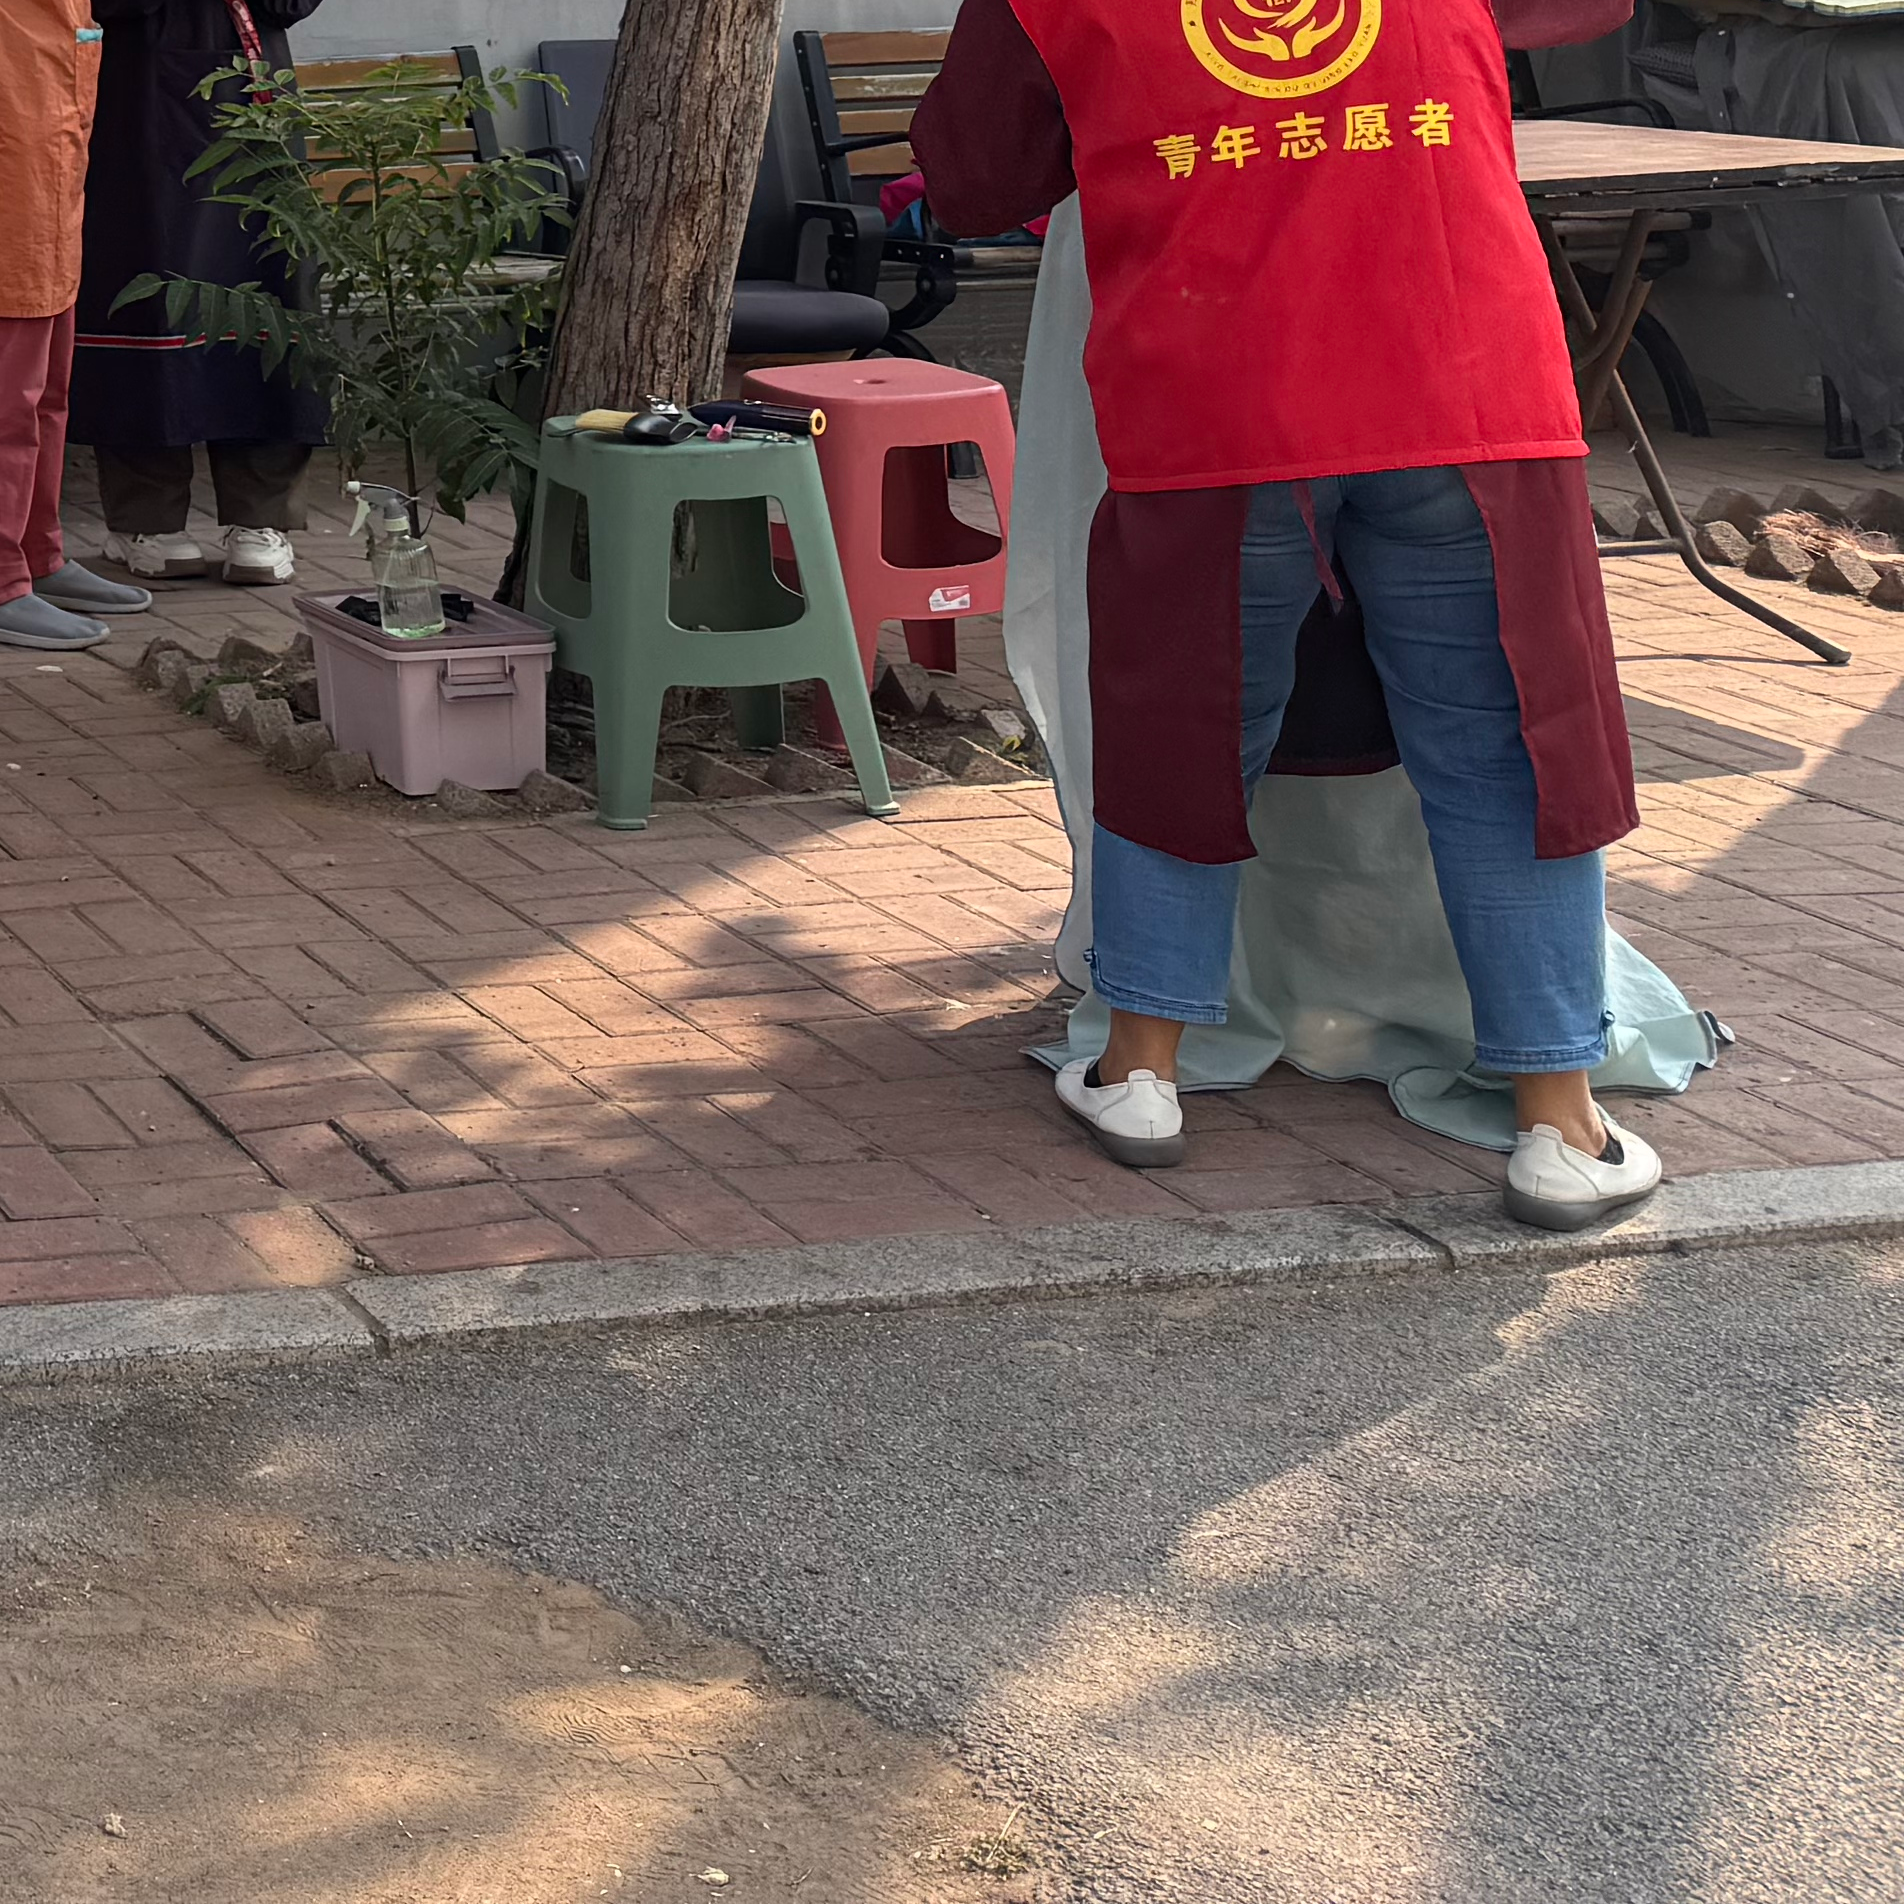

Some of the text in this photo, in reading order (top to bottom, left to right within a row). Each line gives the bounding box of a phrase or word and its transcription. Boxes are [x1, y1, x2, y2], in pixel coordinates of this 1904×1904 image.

[1152, 97, 1455, 181] 青年志愿者
